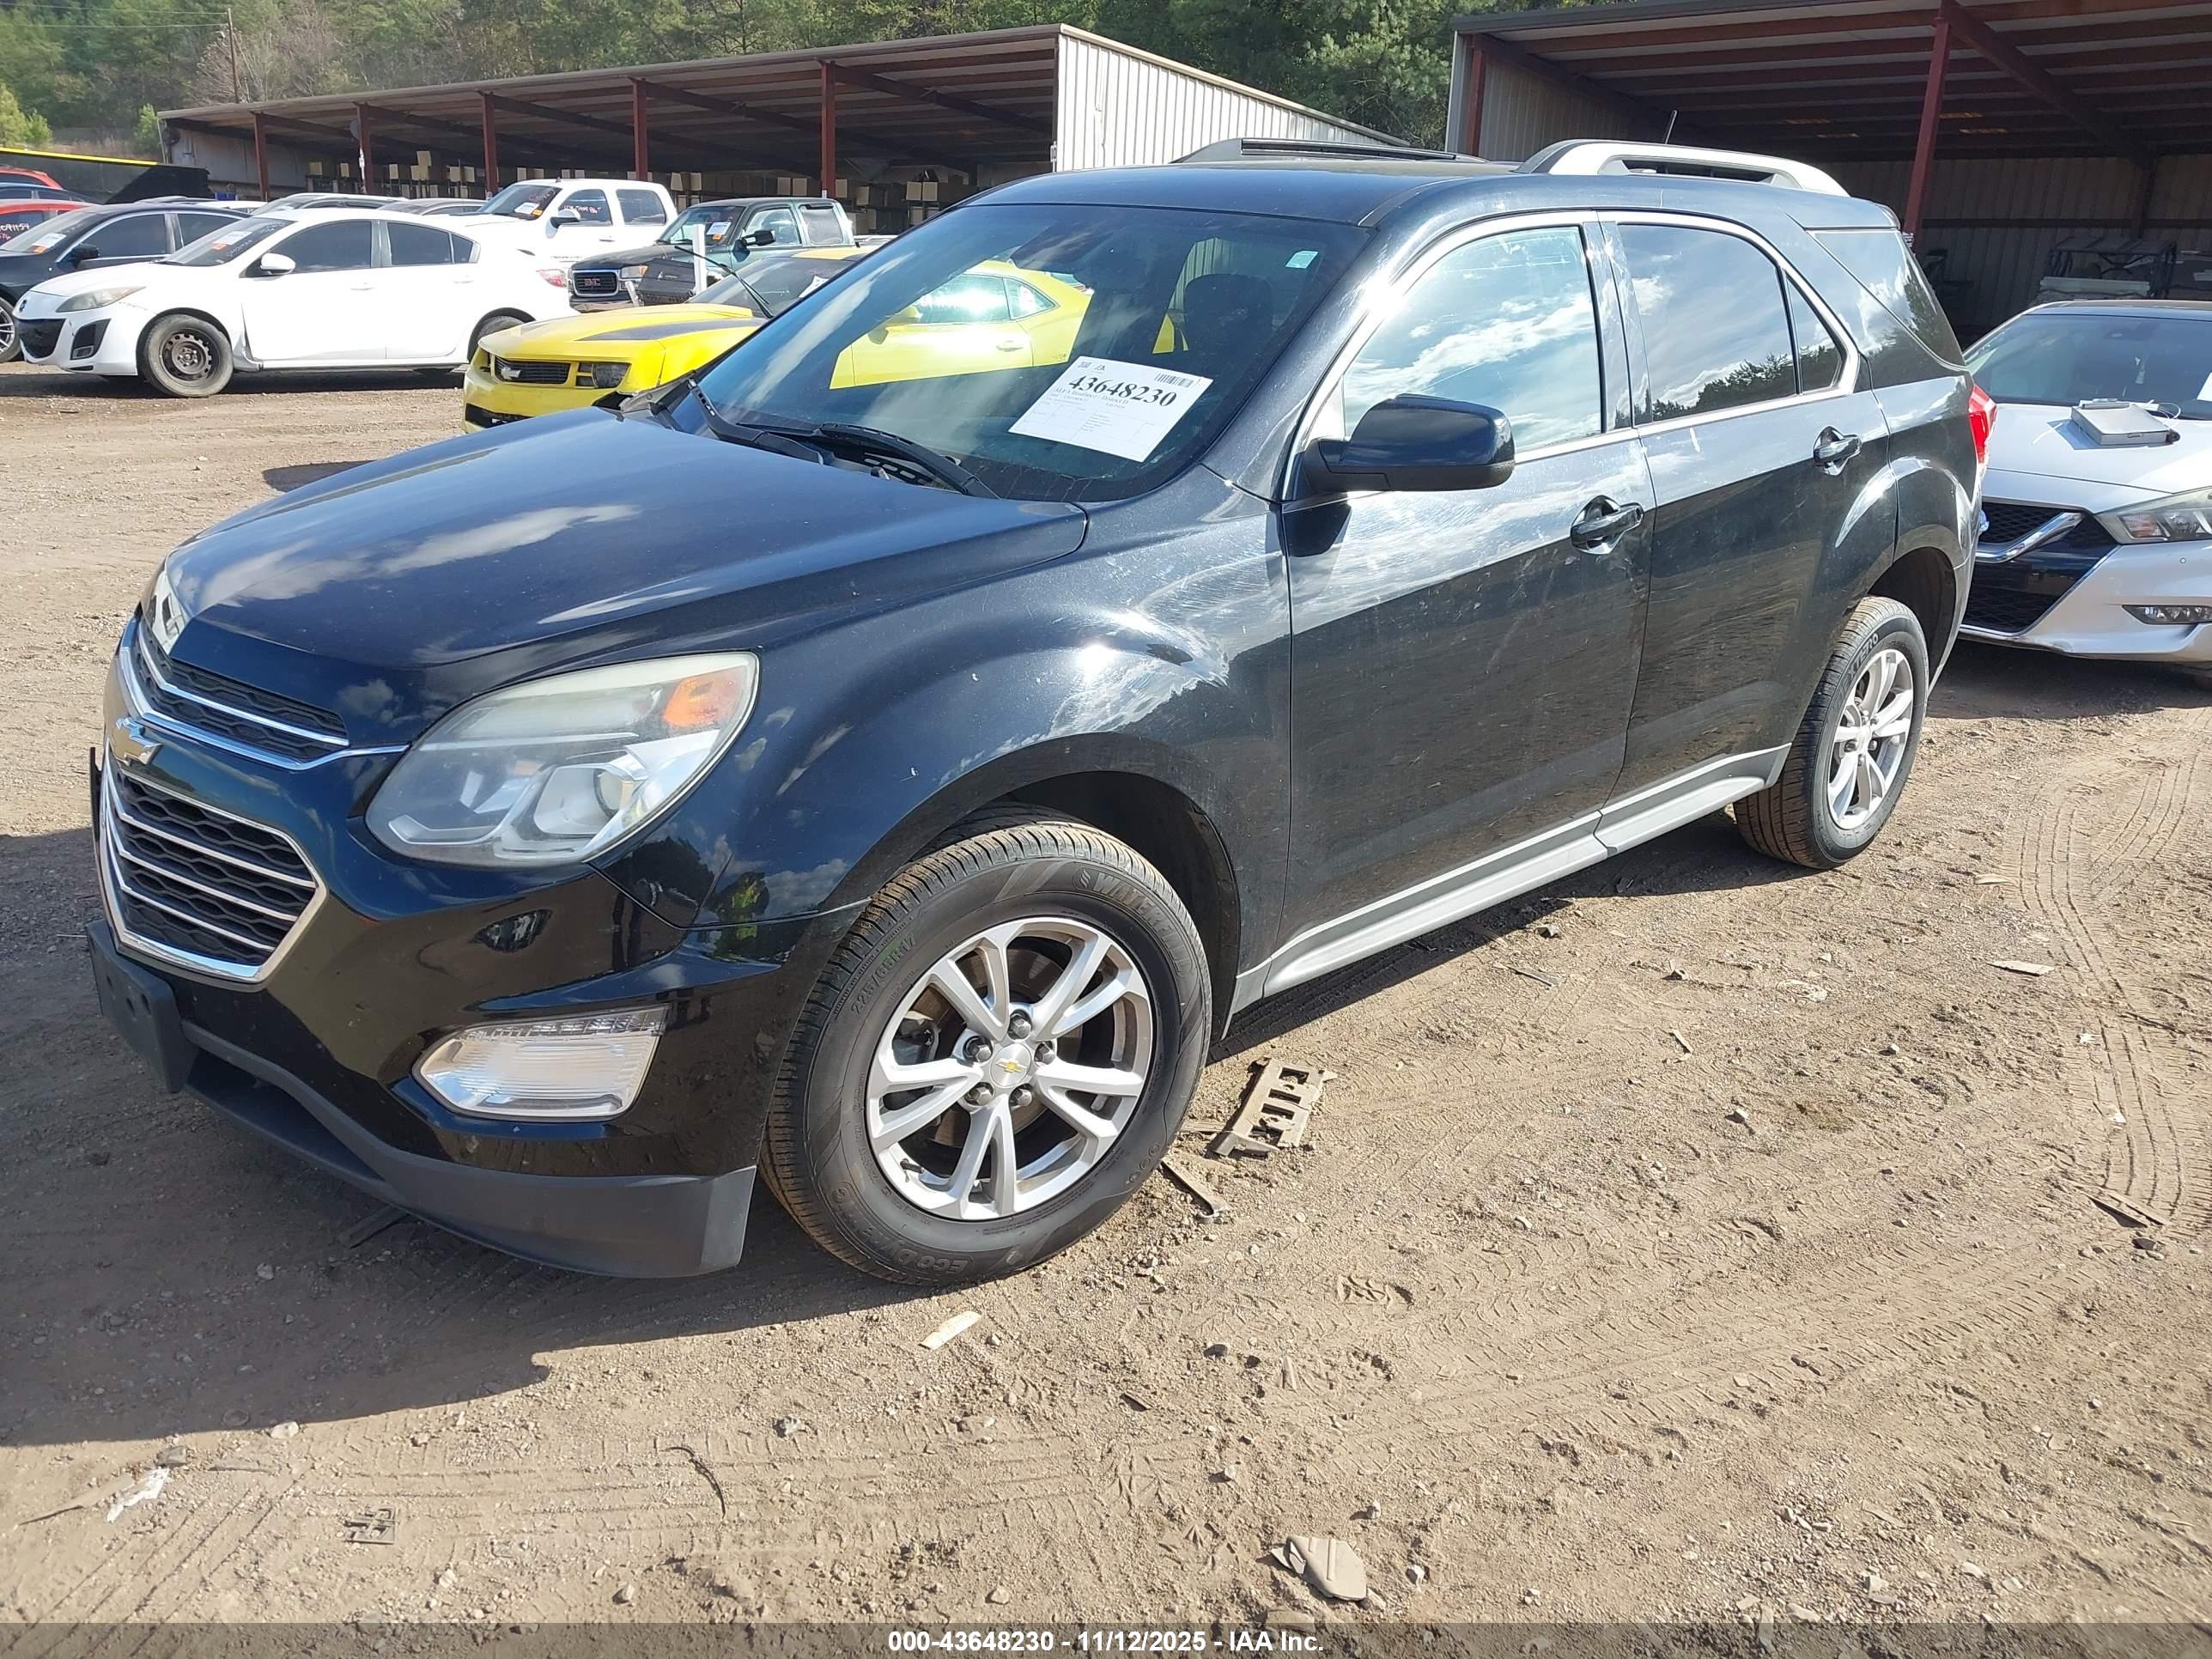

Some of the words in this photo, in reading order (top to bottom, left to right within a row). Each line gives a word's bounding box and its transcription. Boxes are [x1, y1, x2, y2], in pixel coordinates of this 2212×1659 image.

[1068, 375, 1177, 407] 43648230
[1093, 872, 1191, 973] WATERFALL
[851, 934, 915, 1014] 225/65R17
